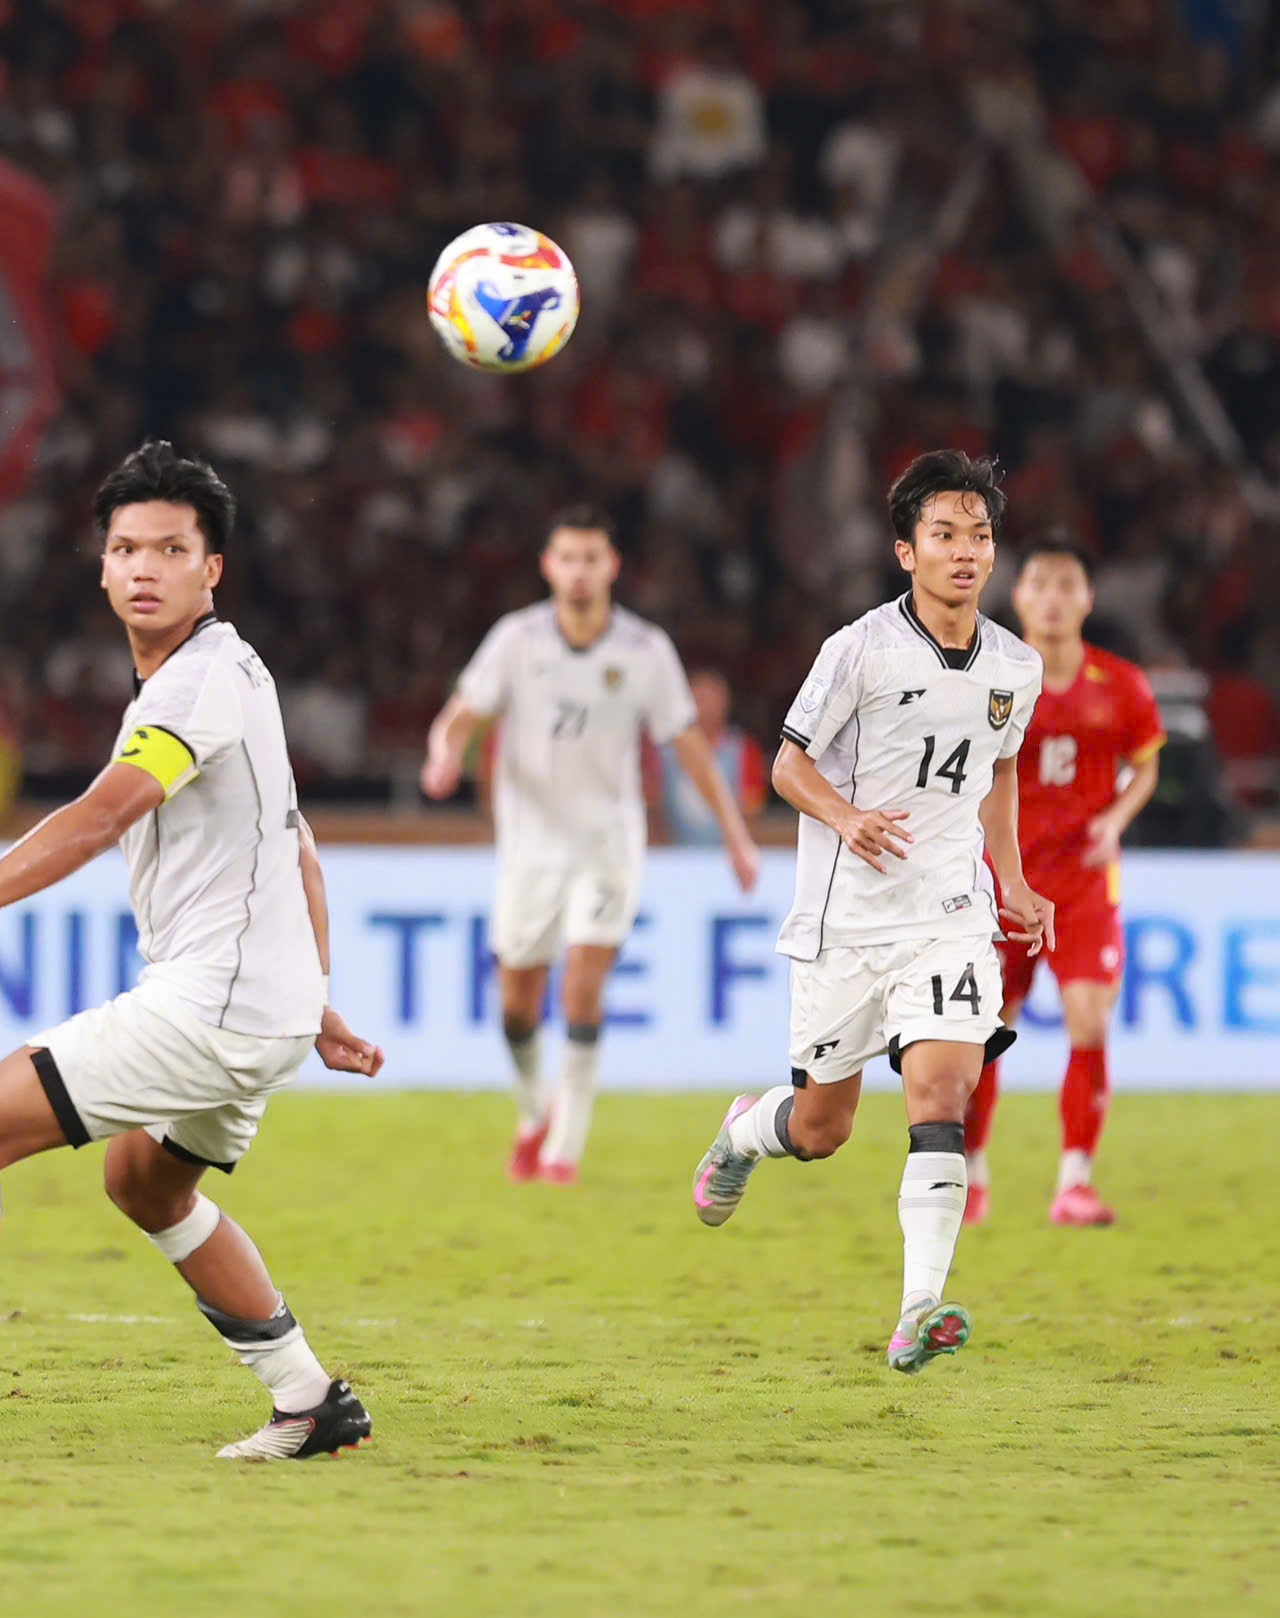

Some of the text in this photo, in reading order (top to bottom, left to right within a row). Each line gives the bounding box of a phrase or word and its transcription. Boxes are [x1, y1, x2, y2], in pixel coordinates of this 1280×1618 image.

[915, 734, 972, 795] 14
[709, 914, 1280, 1025] FRE
[931, 961, 982, 1016] 14
